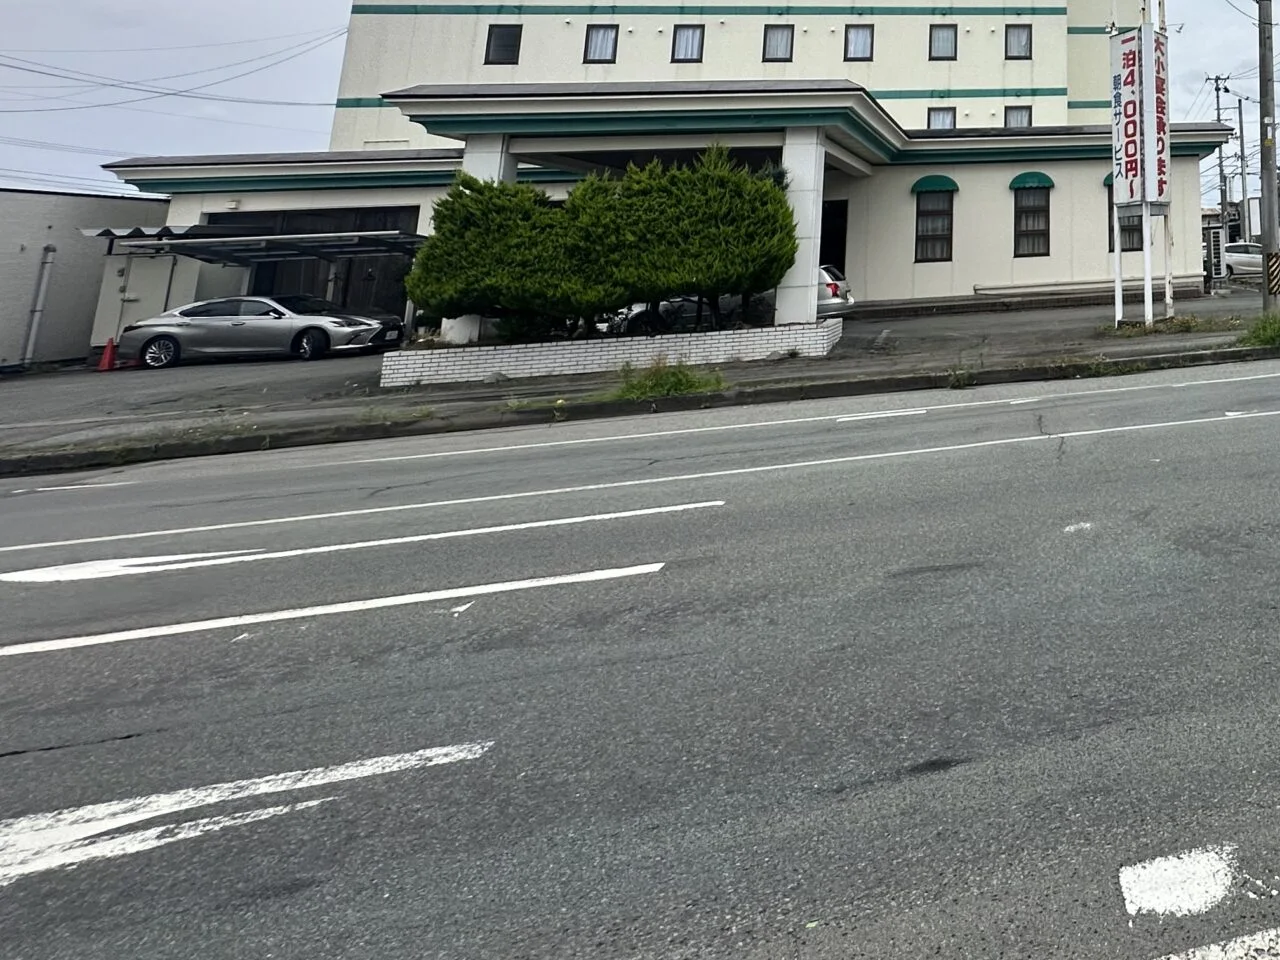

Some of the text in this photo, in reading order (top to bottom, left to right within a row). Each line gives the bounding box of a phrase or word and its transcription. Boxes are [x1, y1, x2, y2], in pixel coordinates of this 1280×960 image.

[1113, 74, 1123, 179] 朝食サービス
